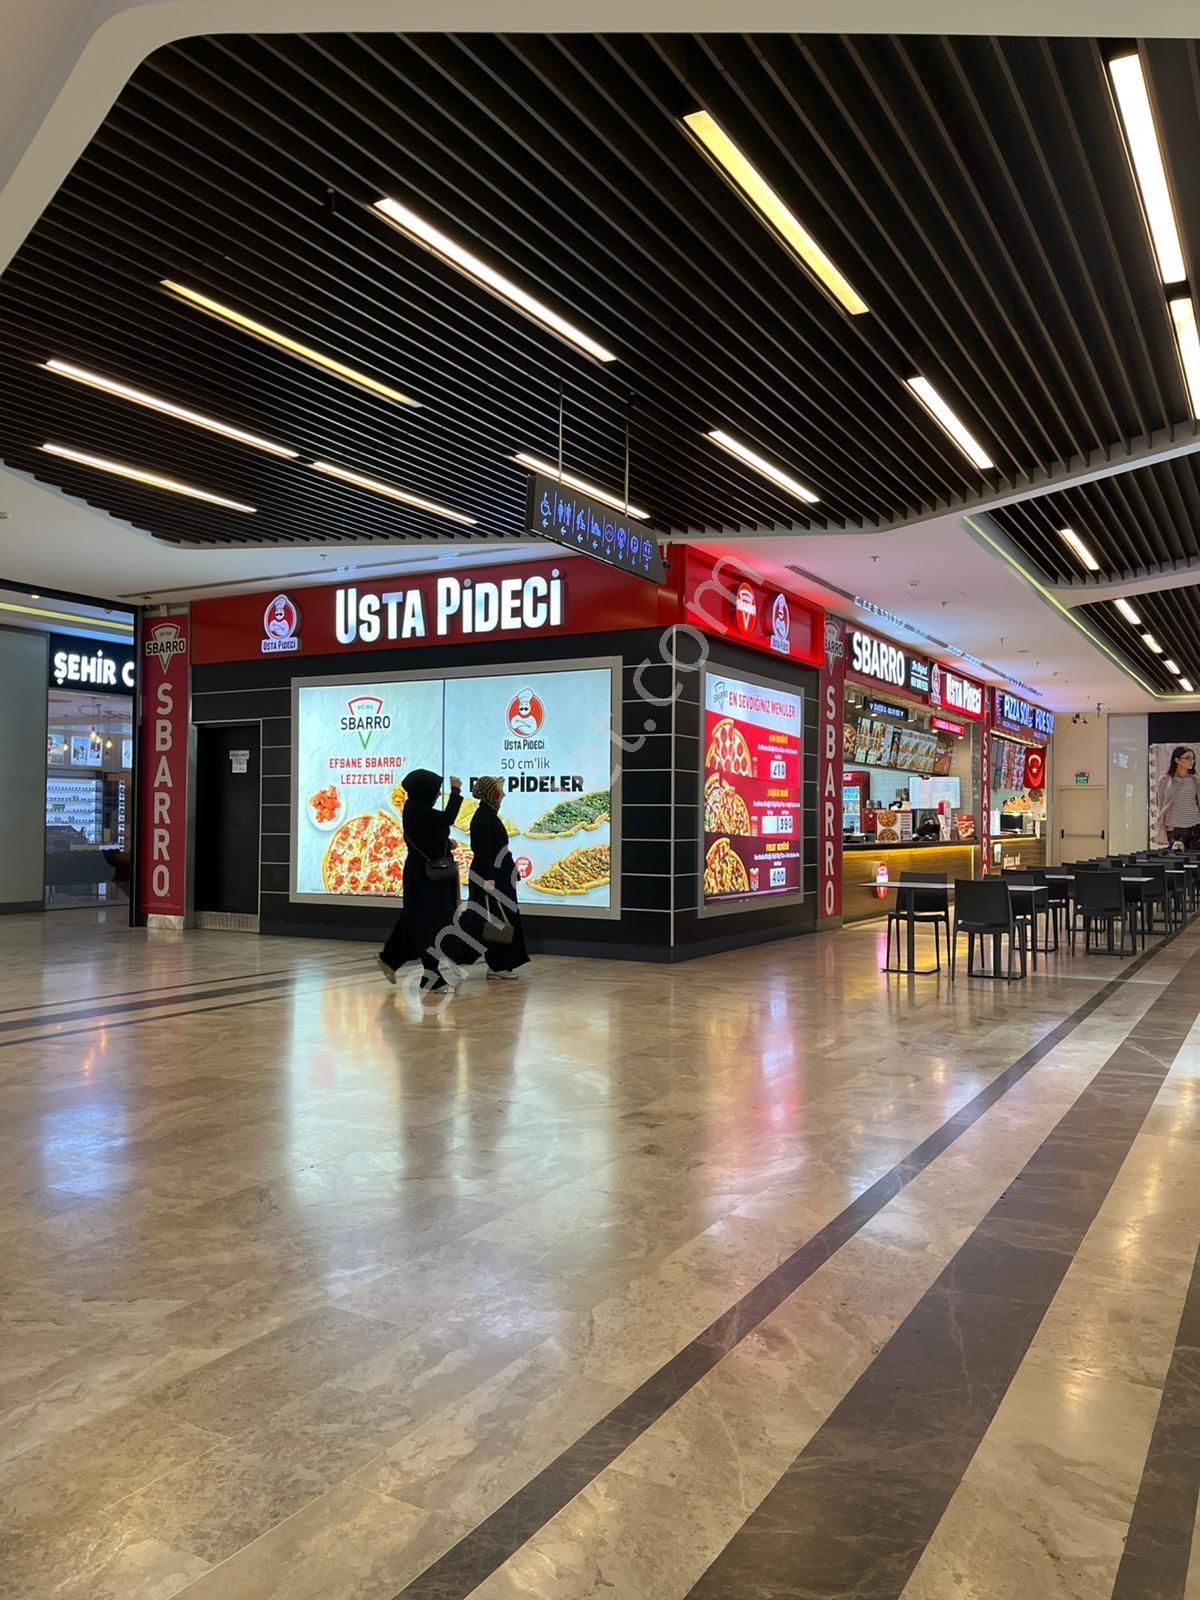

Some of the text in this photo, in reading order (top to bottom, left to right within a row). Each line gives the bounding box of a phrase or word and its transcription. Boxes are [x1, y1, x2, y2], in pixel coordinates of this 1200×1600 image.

[335, 587, 426, 645] USTA
[146, 640, 185, 655] SBARRO
[263, 641, 277, 650] USTA
[824, 639, 843, 656] BARRO
[852, 631, 905, 686] SBARRO
[53, 649, 117, 685] ŞEHİR
[340, 715, 391, 730] SBARRO
[504, 739, 521, 750] USTA
[329, 758, 363, 768] EFSANE
[501, 758, 515, 770] 50
[340, 770, 394, 785] LEZZETLERİ
[508, 772, 584, 793] PİDELER
[152, 682, 174, 897] SBARRO
[825, 685, 836, 915] SBARRO
